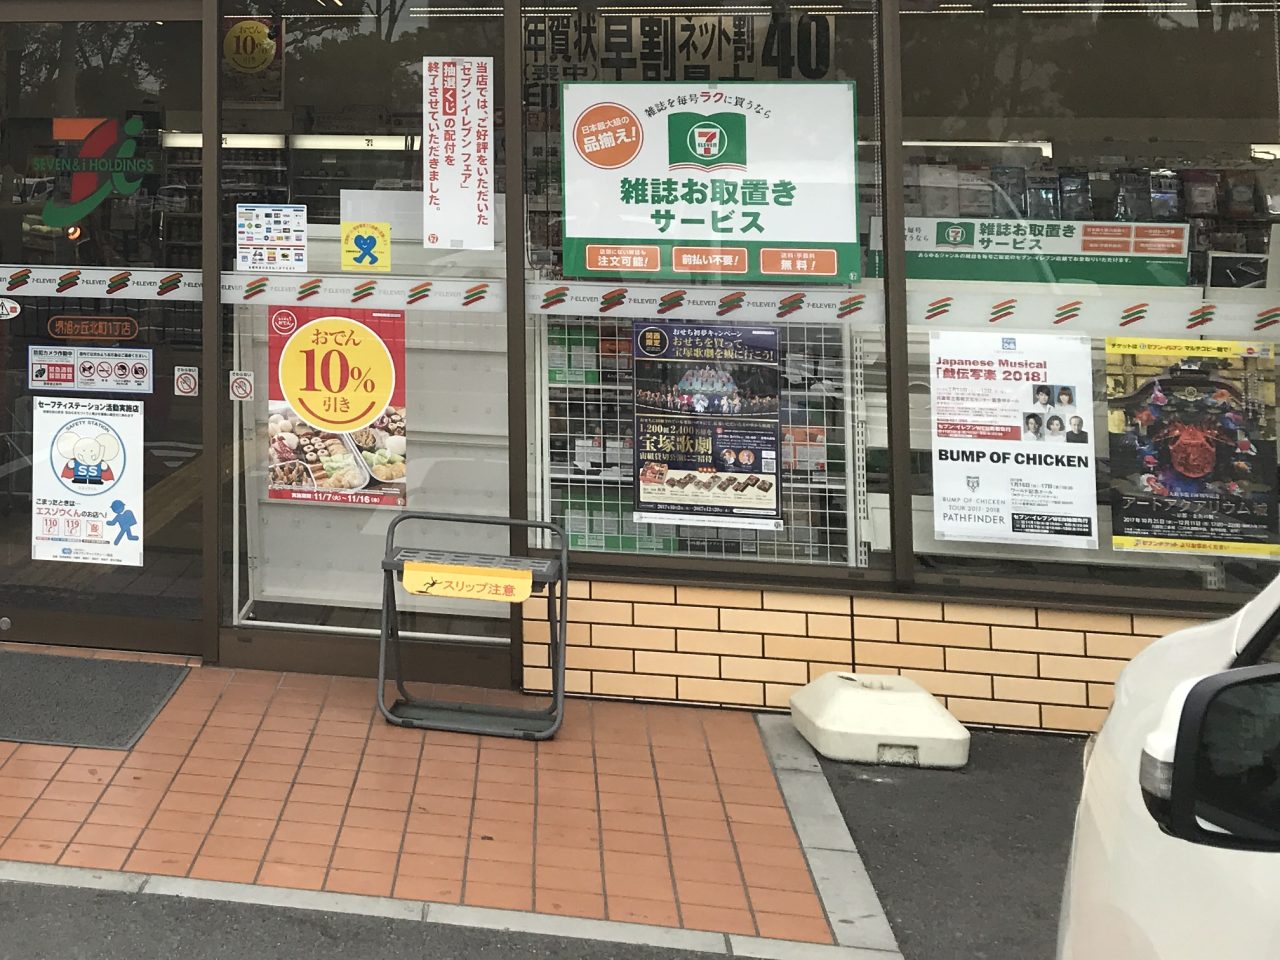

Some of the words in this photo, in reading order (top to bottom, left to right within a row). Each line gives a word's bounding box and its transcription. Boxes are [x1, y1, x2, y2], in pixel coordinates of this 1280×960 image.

[644, 91, 771, 119] 雑誌を毎号ラクに買うなら
[581, 116, 630, 134] 日本最大級の
[428, 62, 441, 211] 終了させていただきました。
[476, 62, 489, 225] 当店では、ご好評をいただいた
[90, 159, 154, 172] HOLDINGS
[620, 177, 797, 207] 雑誌お取置き
[650, 210, 766, 234] サービス
[979, 222, 1076, 238] 雑誌お取置き
[979, 237, 1042, 250] サービス
[312, 328, 361, 347] おでん
[299, 348, 375, 394] 10%
[936, 357, 994, 367] Japanese
[999, 359, 1047, 369] Musical
[38, 401, 140, 413] セーフティステーション活動実施店
[322, 397, 350, 413] 引き
[87, 420, 110, 433] STATION
[640, 434, 713, 454] 宝塚歌劇
[938, 449, 986, 463] BUMP
[990, 451, 1011, 464] OF
[1014, 453, 1089, 468] CHICKEN
[78, 465, 98, 476] SS
[44, 519, 58, 527] 110
[66, 520, 79, 528] 119
[943, 512, 1005, 524] PATHFINDER
[443, 580, 516, 597] スリップ注意
